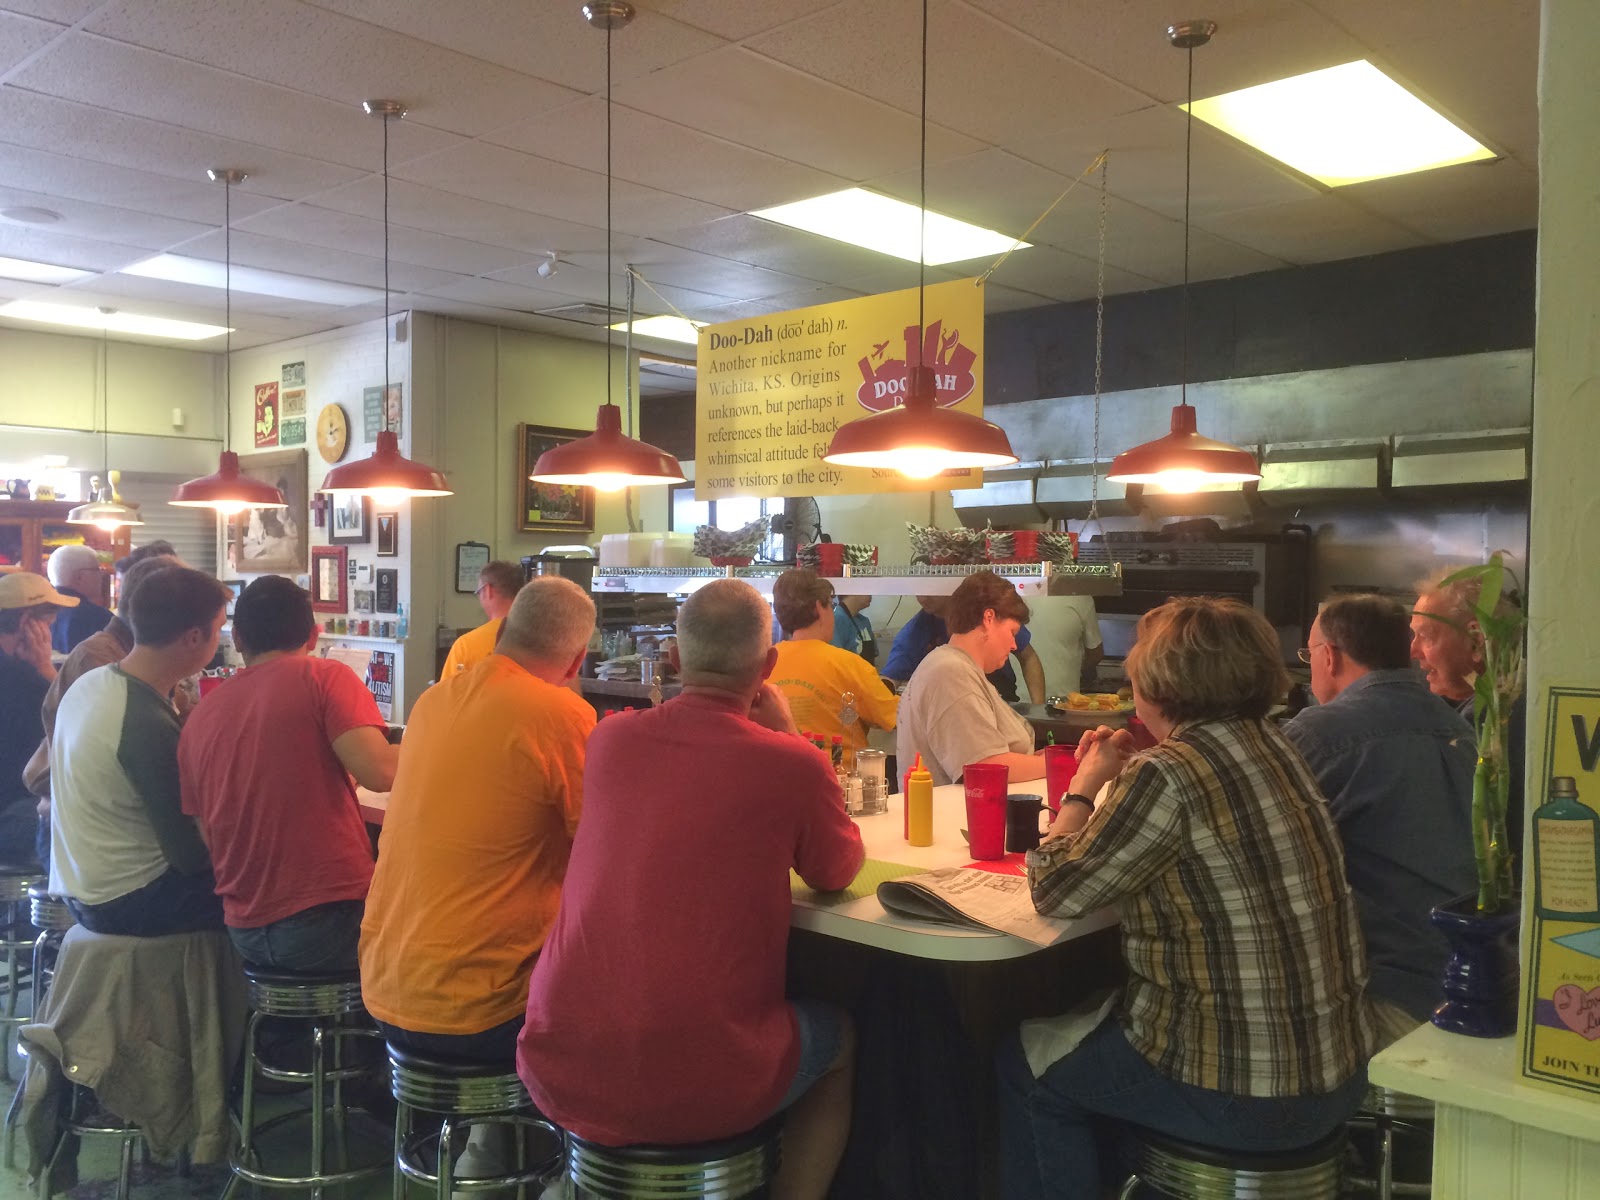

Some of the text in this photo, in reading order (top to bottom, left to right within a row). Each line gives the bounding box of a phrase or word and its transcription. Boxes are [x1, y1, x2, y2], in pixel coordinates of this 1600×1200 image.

[710, 324, 773, 351] Doo-Dah
[807, 317, 833, 336] dah)
[837, 319, 848, 331] n.
[708, 341, 847, 374] Another nickname for
[709, 368, 840, 396] Wichita, KS. Origins
[708, 391, 844, 420] unknown, but perhaps it
[708, 416, 840, 443] references the laid-back
[708, 447, 762, 466] whimsical
[765, 444, 809, 462] attitude
[707, 467, 843, 489] some visitors to the city.
[368, 680, 391, 697] AUTISM
[1542, 1056, 1580, 1073] JOIN
